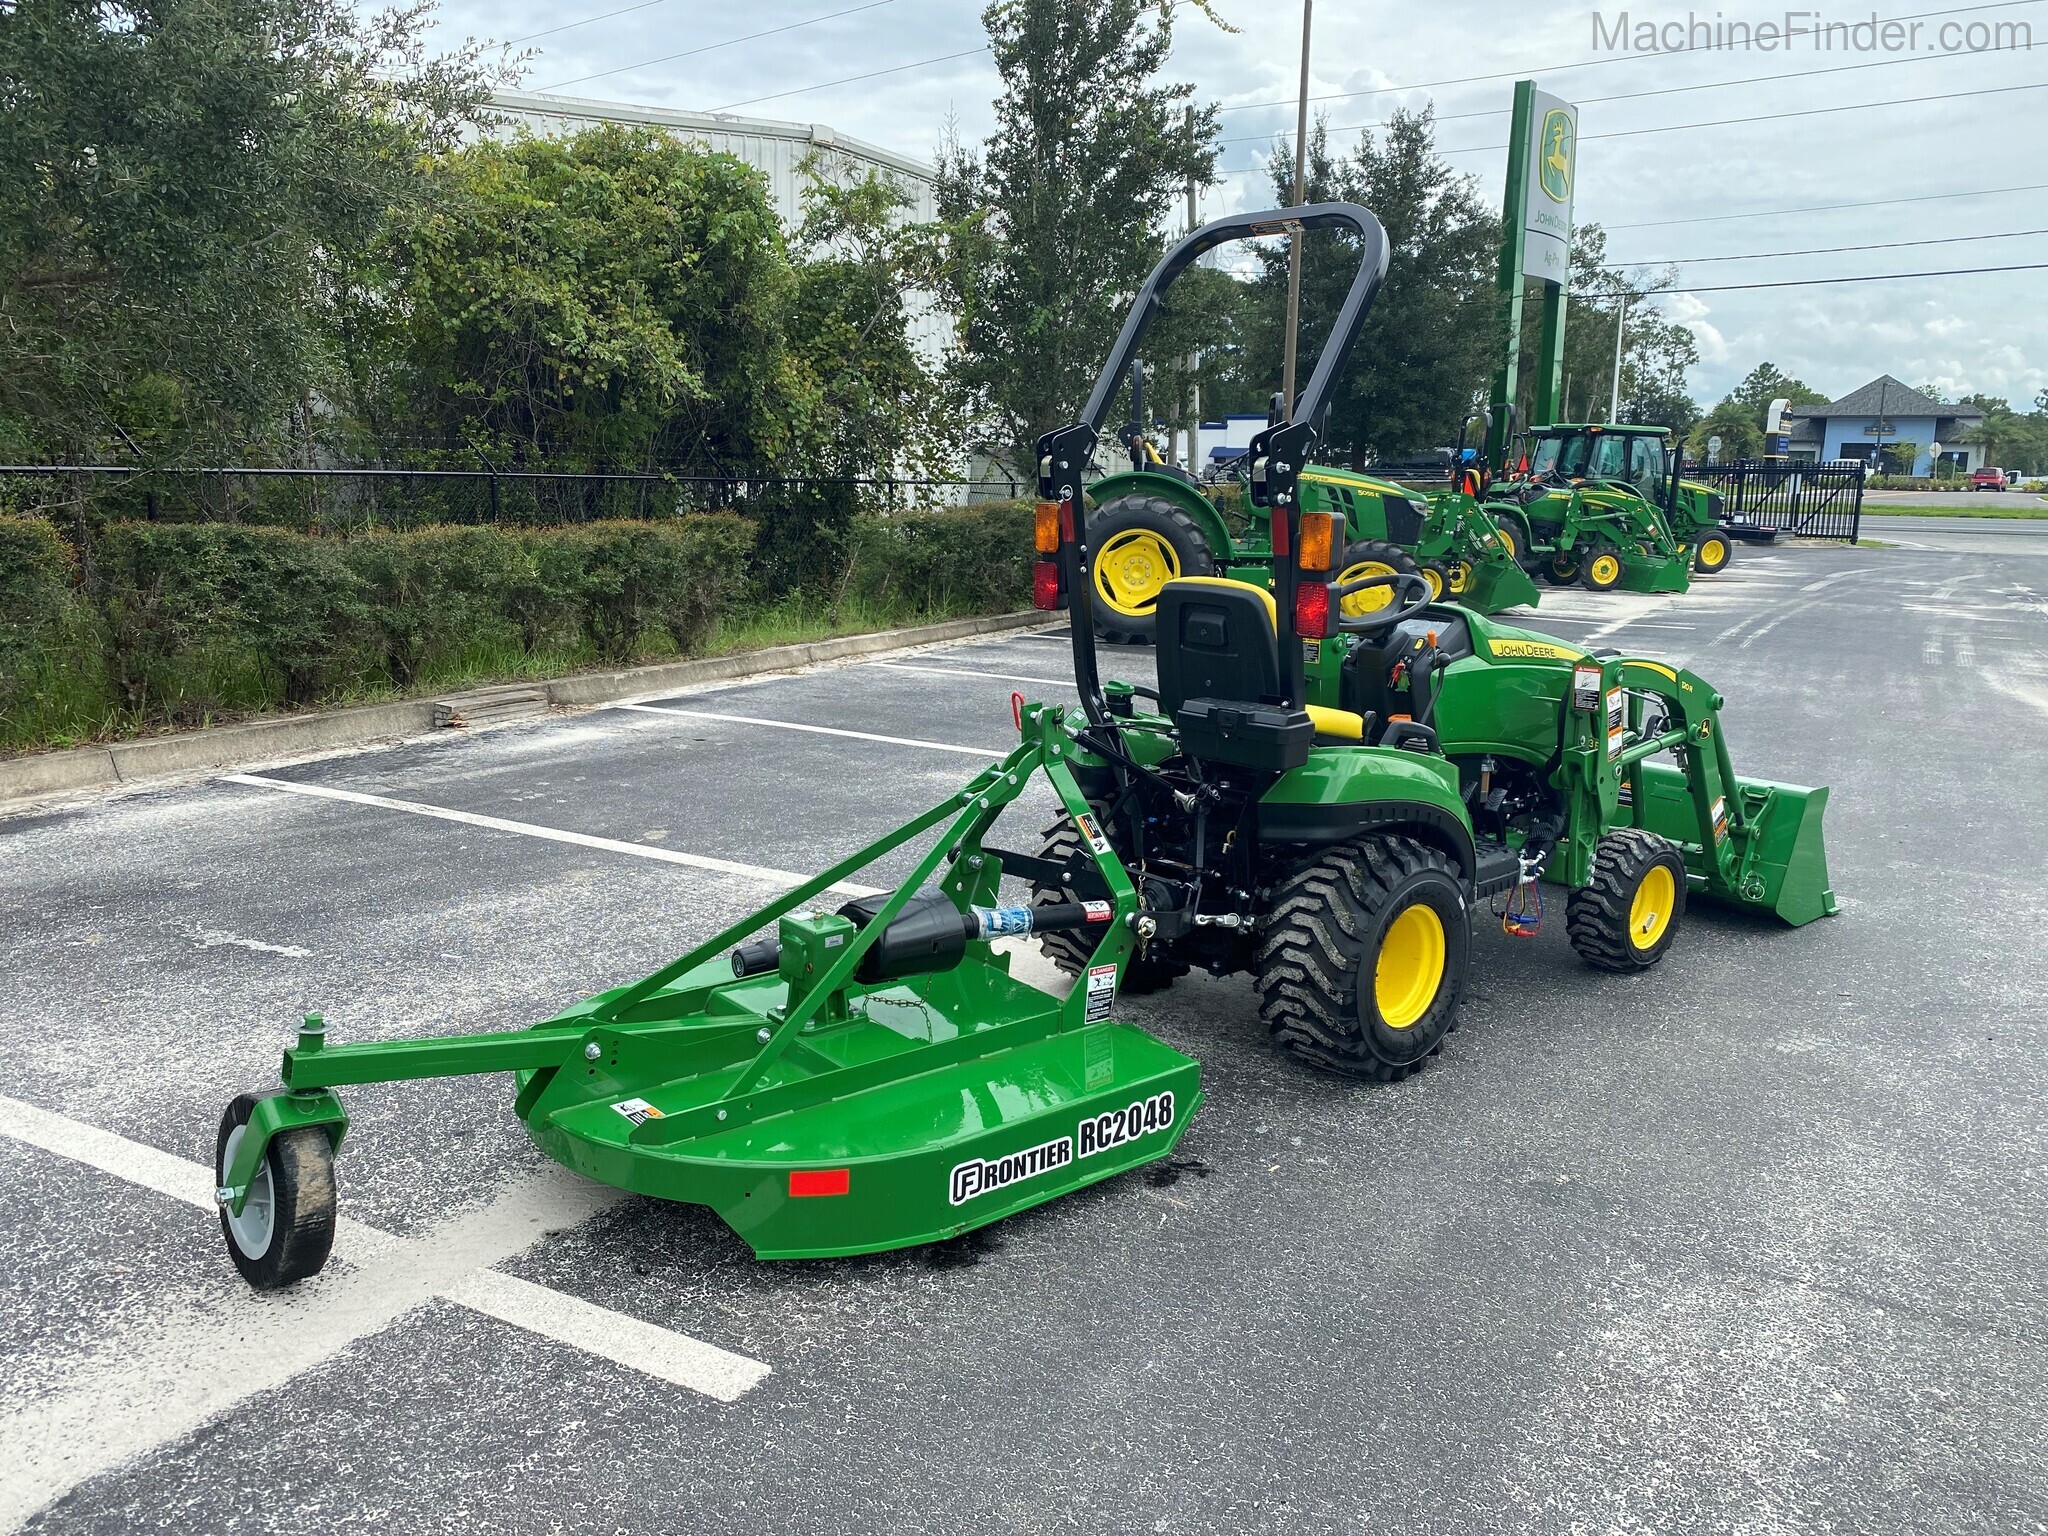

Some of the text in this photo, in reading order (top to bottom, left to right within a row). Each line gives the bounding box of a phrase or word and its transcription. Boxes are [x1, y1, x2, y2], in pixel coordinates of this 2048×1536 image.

[1534, 210, 1554, 227] JOHN
[1498, 643, 1556, 657] JOHN DEERE
[1096, 966, 1115, 974] DANGER
[952, 1094, 1173, 1203] FRONTIER RC2048
